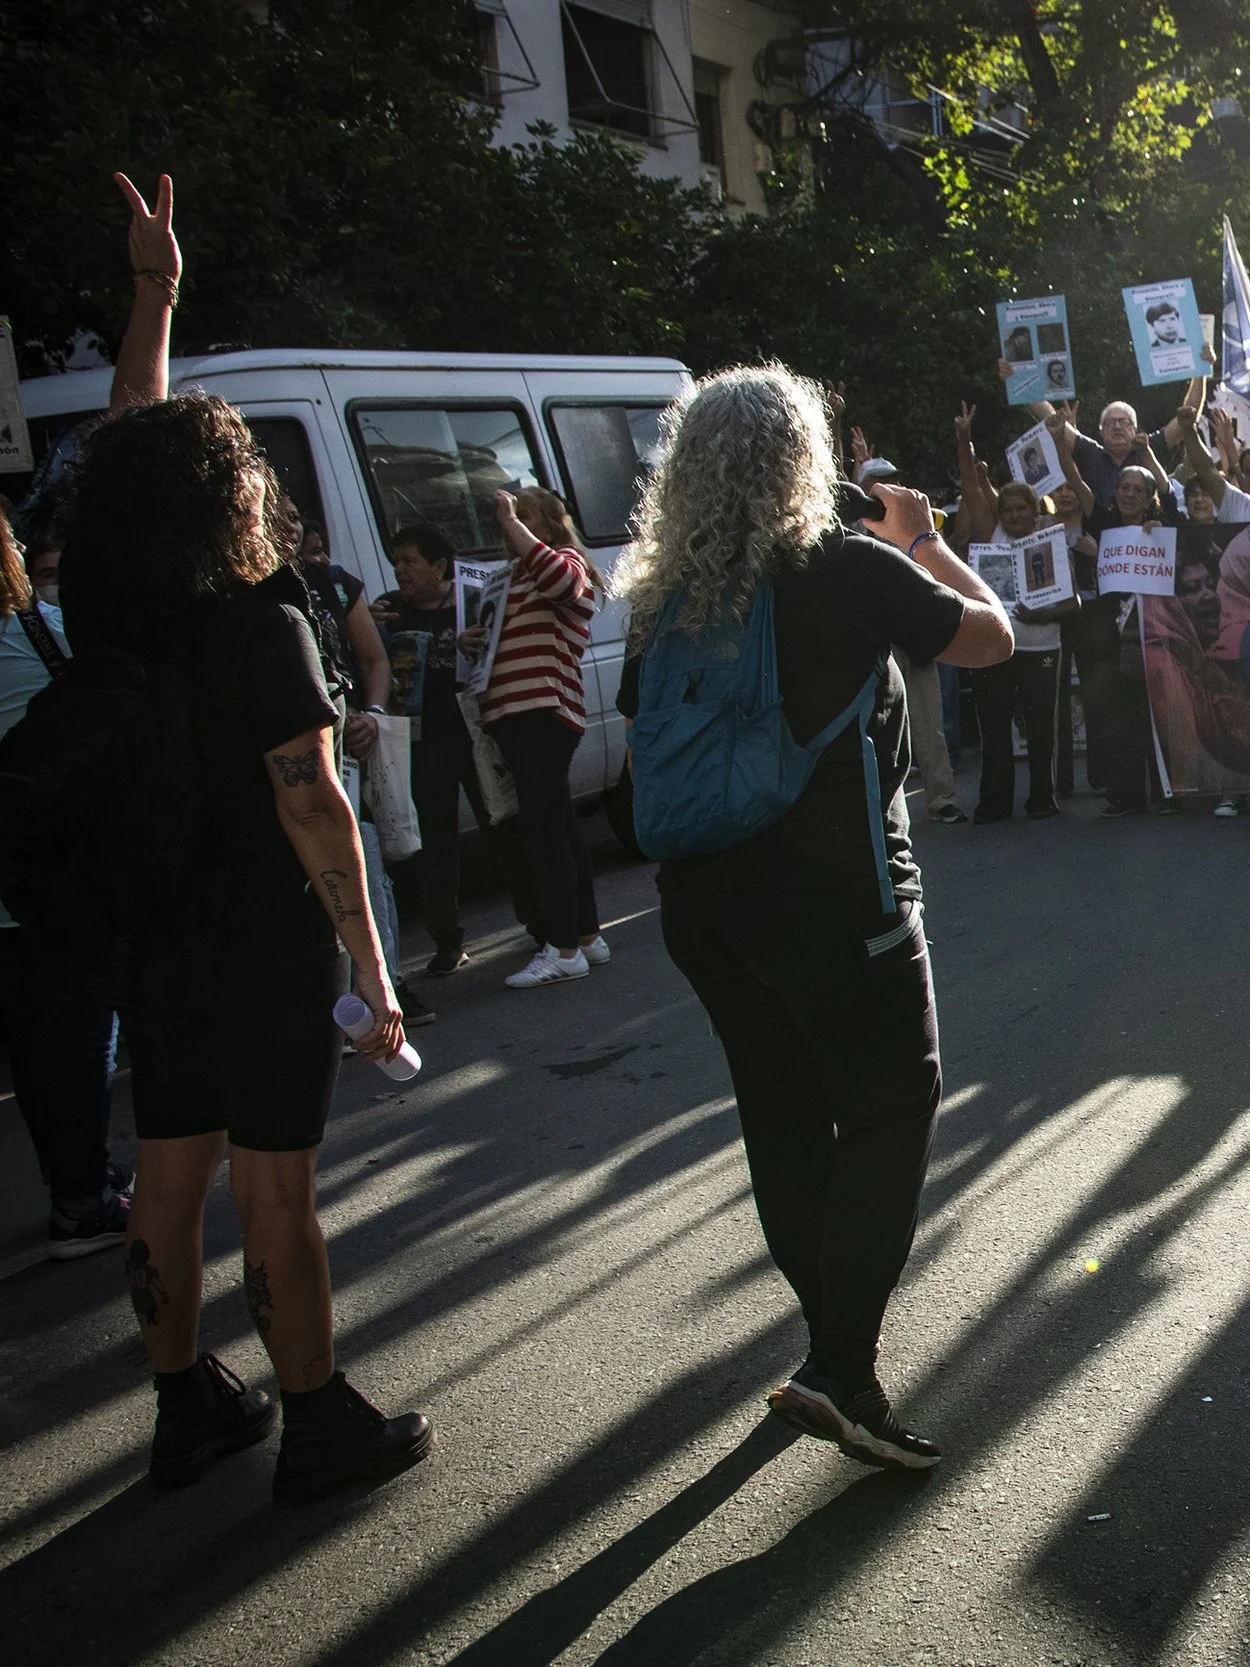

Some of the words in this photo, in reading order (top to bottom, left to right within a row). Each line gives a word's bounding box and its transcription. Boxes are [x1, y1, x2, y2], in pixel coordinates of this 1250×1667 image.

[1103, 545, 1123, 559] QUE
[1126, 544, 1166, 558] DIGAN
[460, 565, 490, 581] PRES
[1134, 562, 1173, 577] ESTÁN
